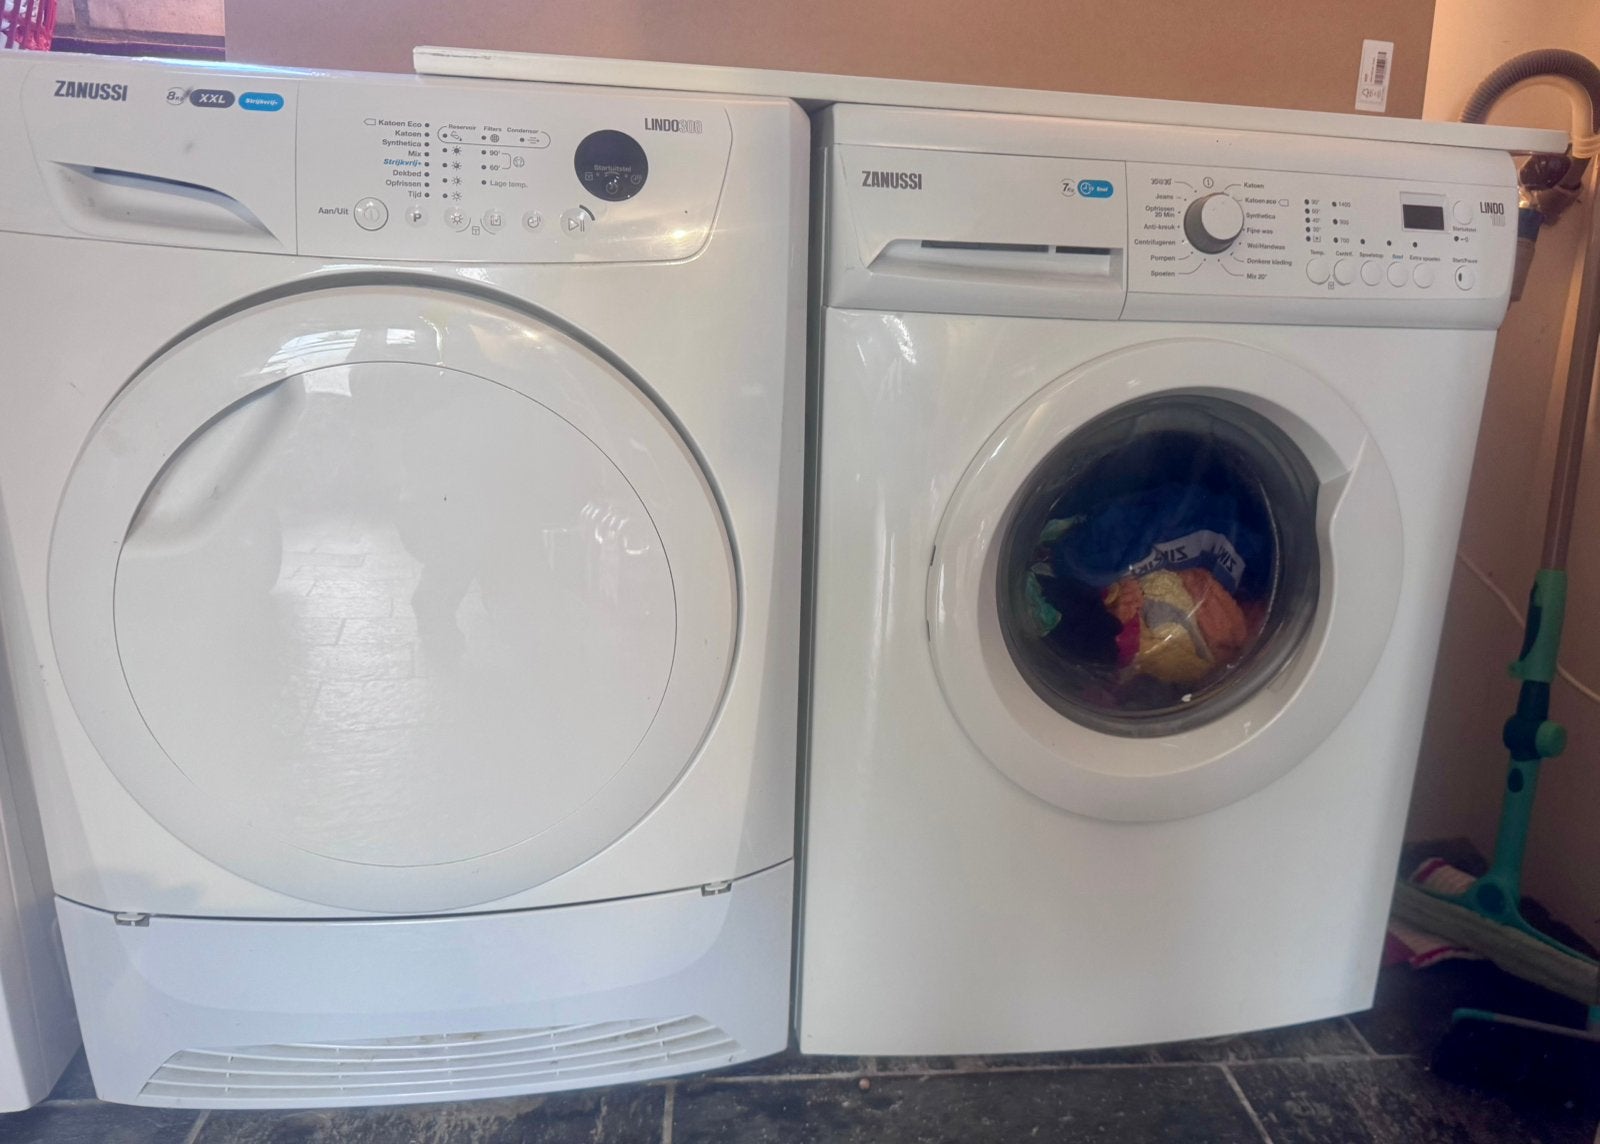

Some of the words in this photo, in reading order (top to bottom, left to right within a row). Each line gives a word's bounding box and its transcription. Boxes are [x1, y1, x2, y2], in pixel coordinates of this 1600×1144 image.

[54, 80, 128, 101] ZANUSSI
[199, 93, 226, 104] XXL
[378, 119, 405, 127] Katoen
[382, 139, 422, 148] Synthetica
[385, 179, 422, 188] Opfrissen
[490, 180, 507, 188] Lage
[509, 181, 528, 189] temp.
[862, 170, 922, 190] ZANUSSI
[408, 190, 422, 199] Tijd
[318, 206, 349, 216] Aan/Uit
[1480, 201, 1504, 215] LINDO
[412, 212, 422, 222] P
